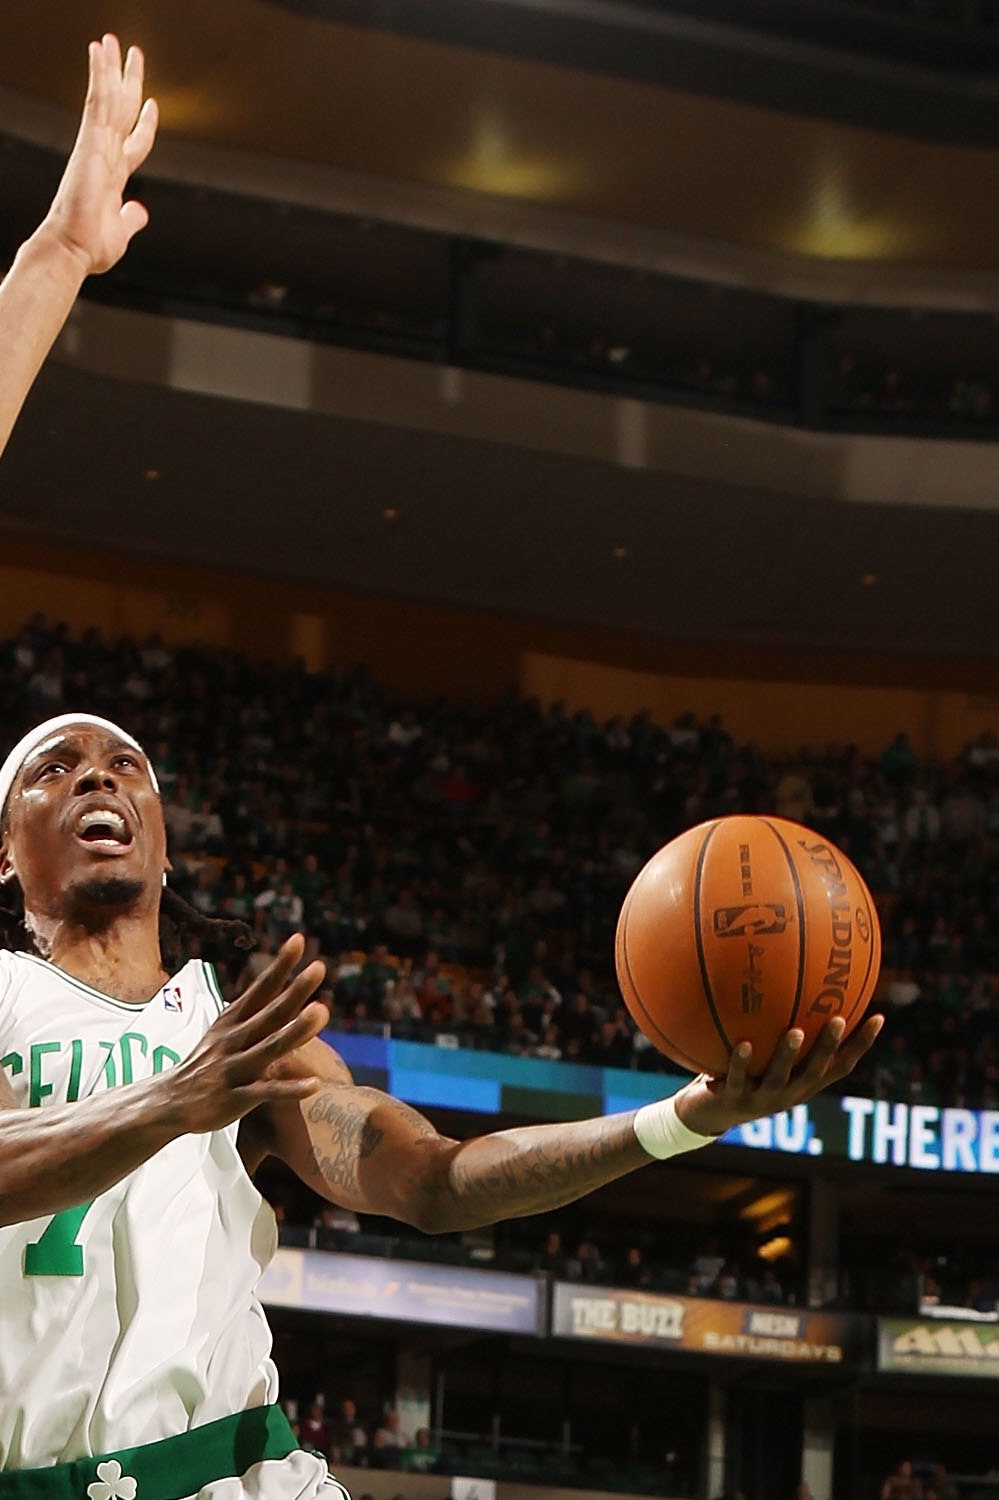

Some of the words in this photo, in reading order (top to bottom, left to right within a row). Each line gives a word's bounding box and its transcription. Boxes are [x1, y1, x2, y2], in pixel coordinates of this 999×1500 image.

[797, 840, 853, 1019] SPALDING
[841, 1096, 999, 1174] THERE
[571, 1297, 618, 1330] THE
[620, 1301, 687, 1340] BUZZ
[702, 1331, 843, 1363] SATURDAYS
